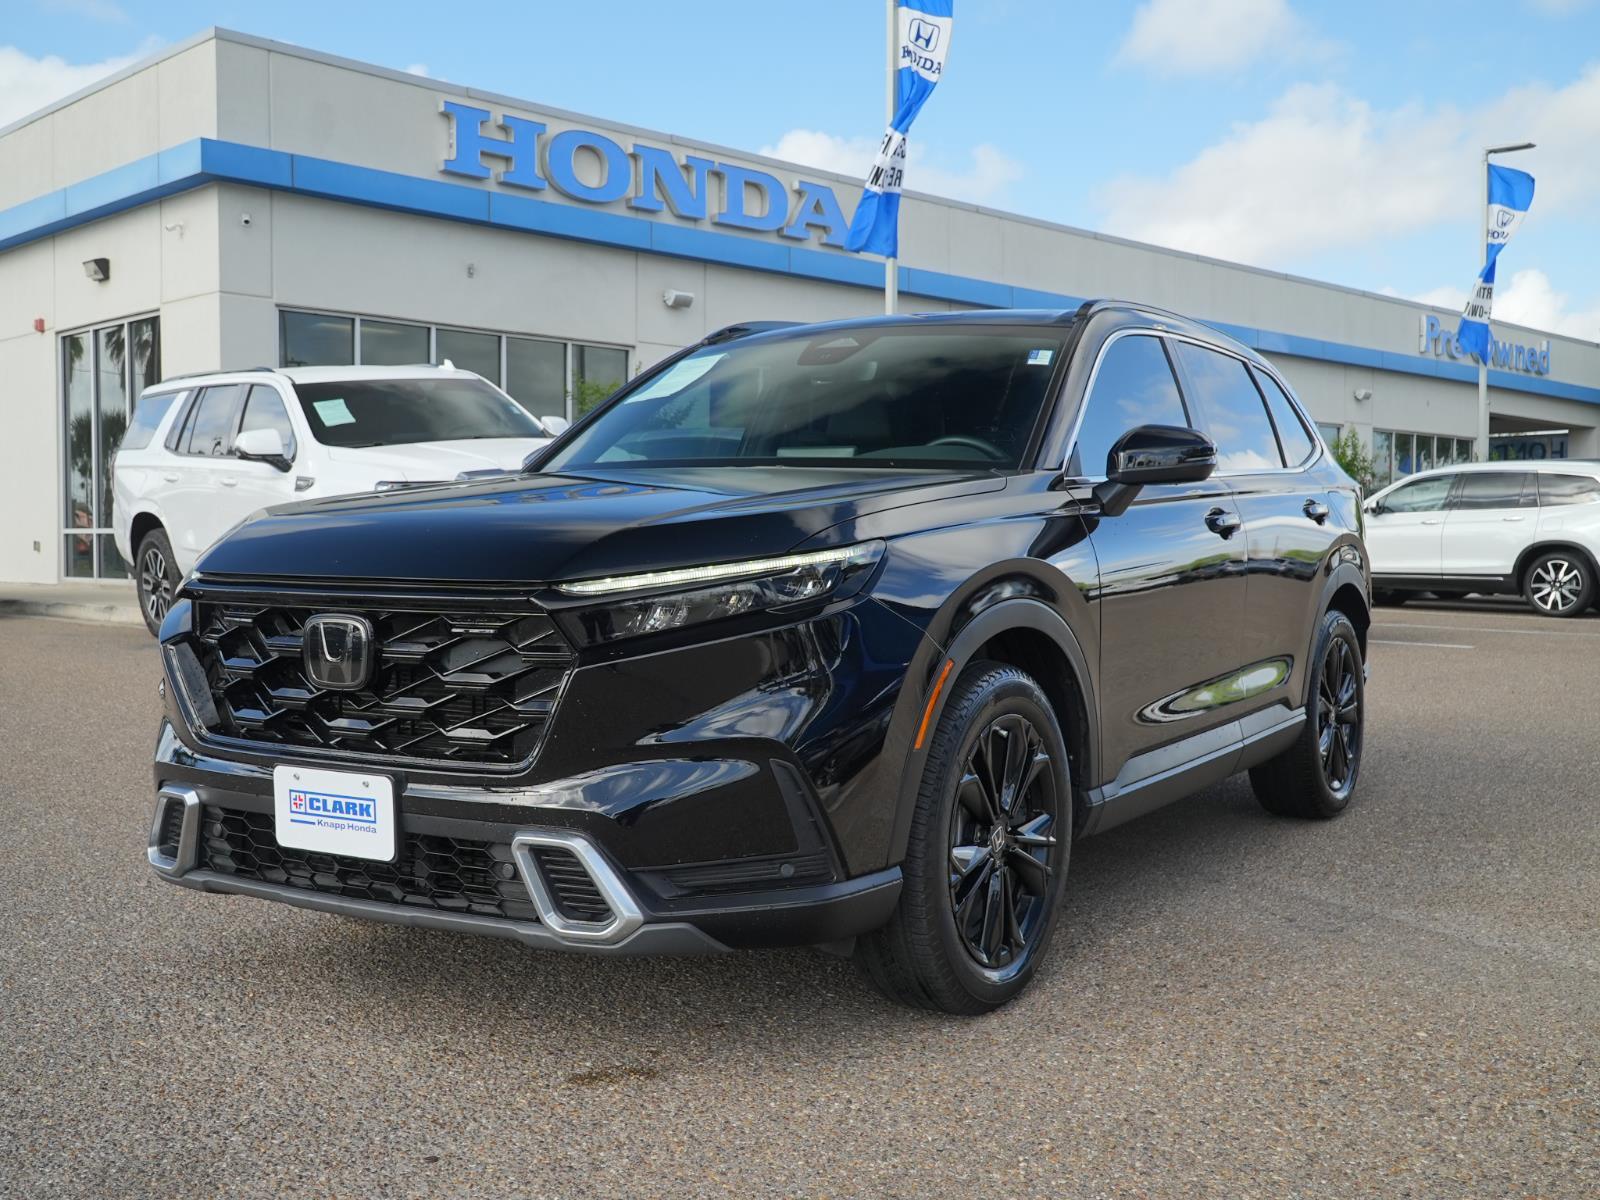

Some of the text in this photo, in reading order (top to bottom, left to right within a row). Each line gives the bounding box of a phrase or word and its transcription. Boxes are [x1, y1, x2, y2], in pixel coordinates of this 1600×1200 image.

[439, 100, 849, 250] HONDA
[309, 796, 372, 818] CLARK
[317, 819, 377, 834] Knapp Honda
